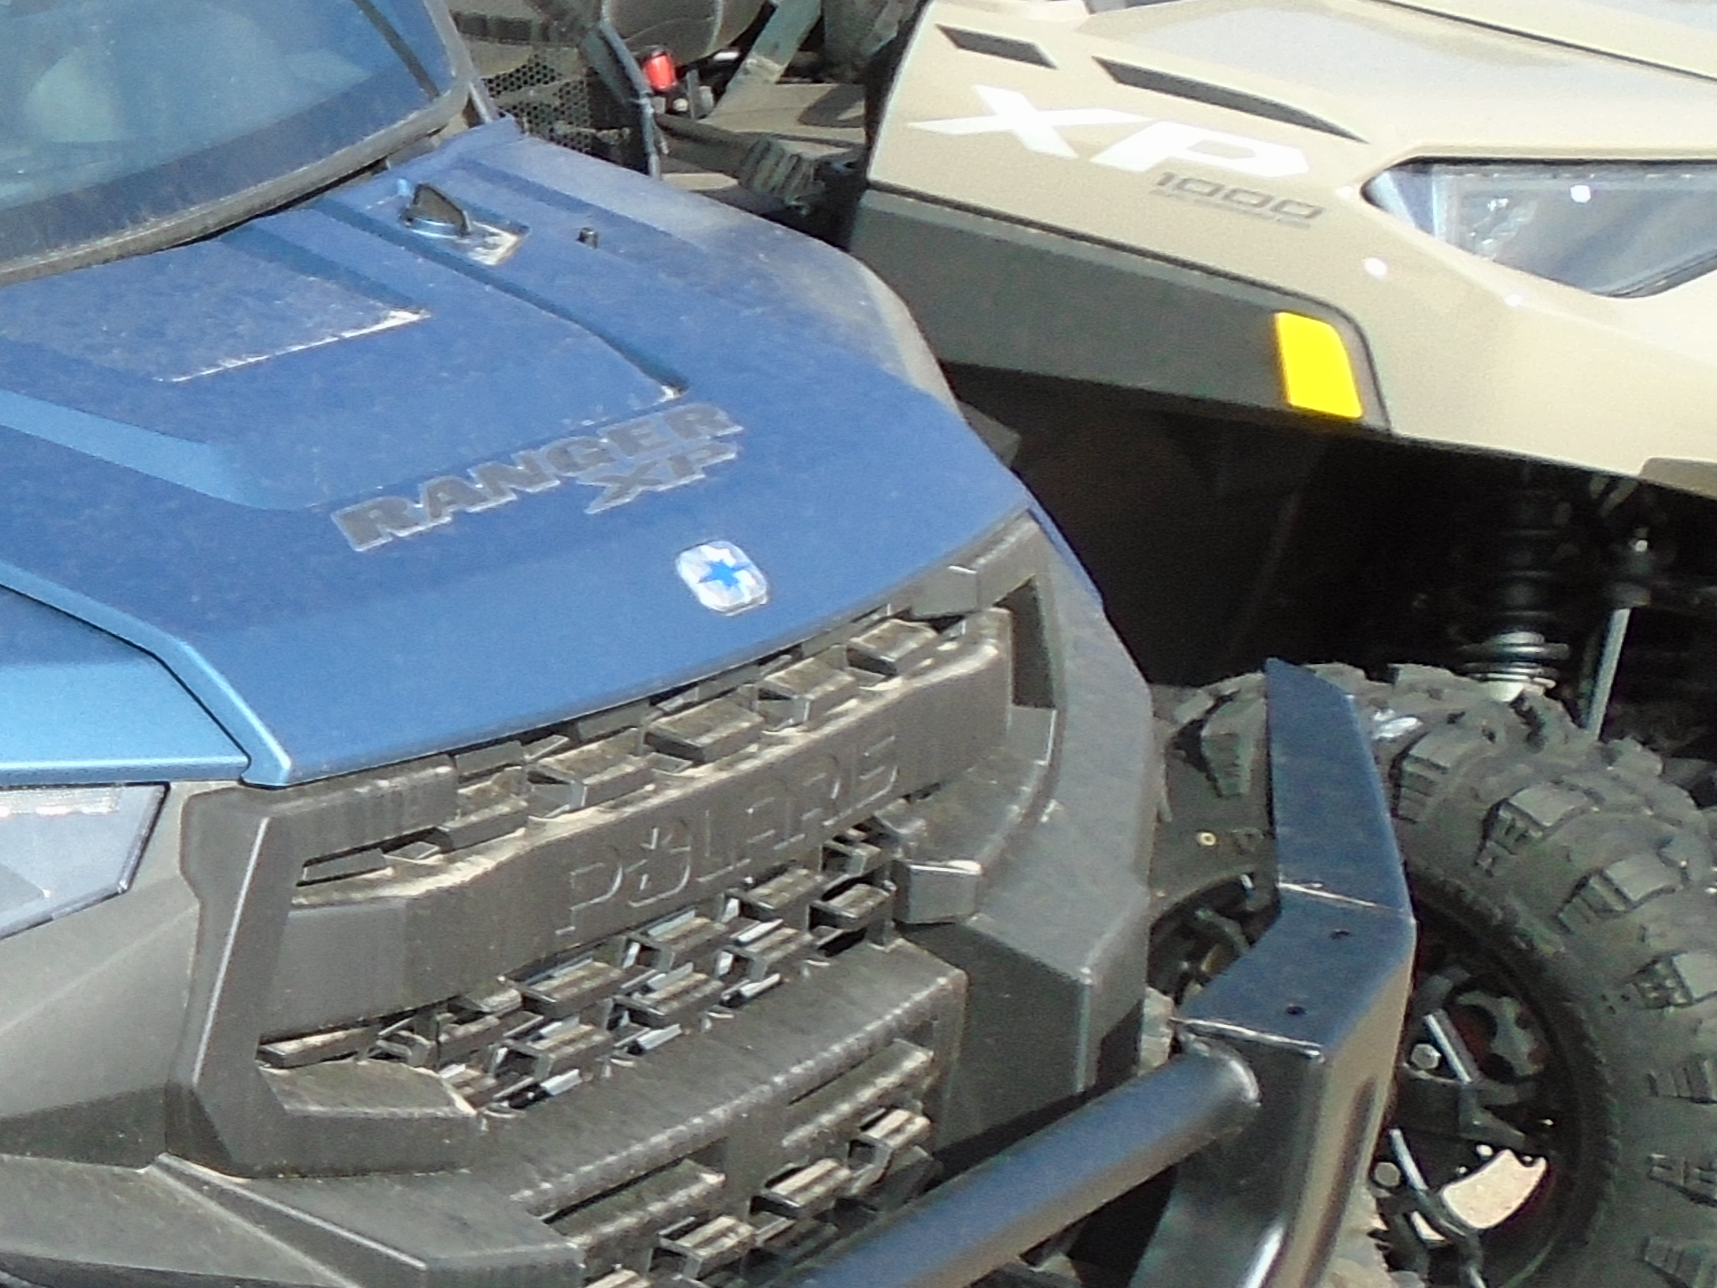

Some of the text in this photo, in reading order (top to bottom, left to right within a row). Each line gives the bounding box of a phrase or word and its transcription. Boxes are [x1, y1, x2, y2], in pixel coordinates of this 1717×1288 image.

[907, 84, 1310, 179] XP
[1156, 171, 1326, 220] 1000
[329, 402, 744, 552] RANGER
[576, 440, 738, 514] XP
[555, 734, 900, 935] POLARIS
